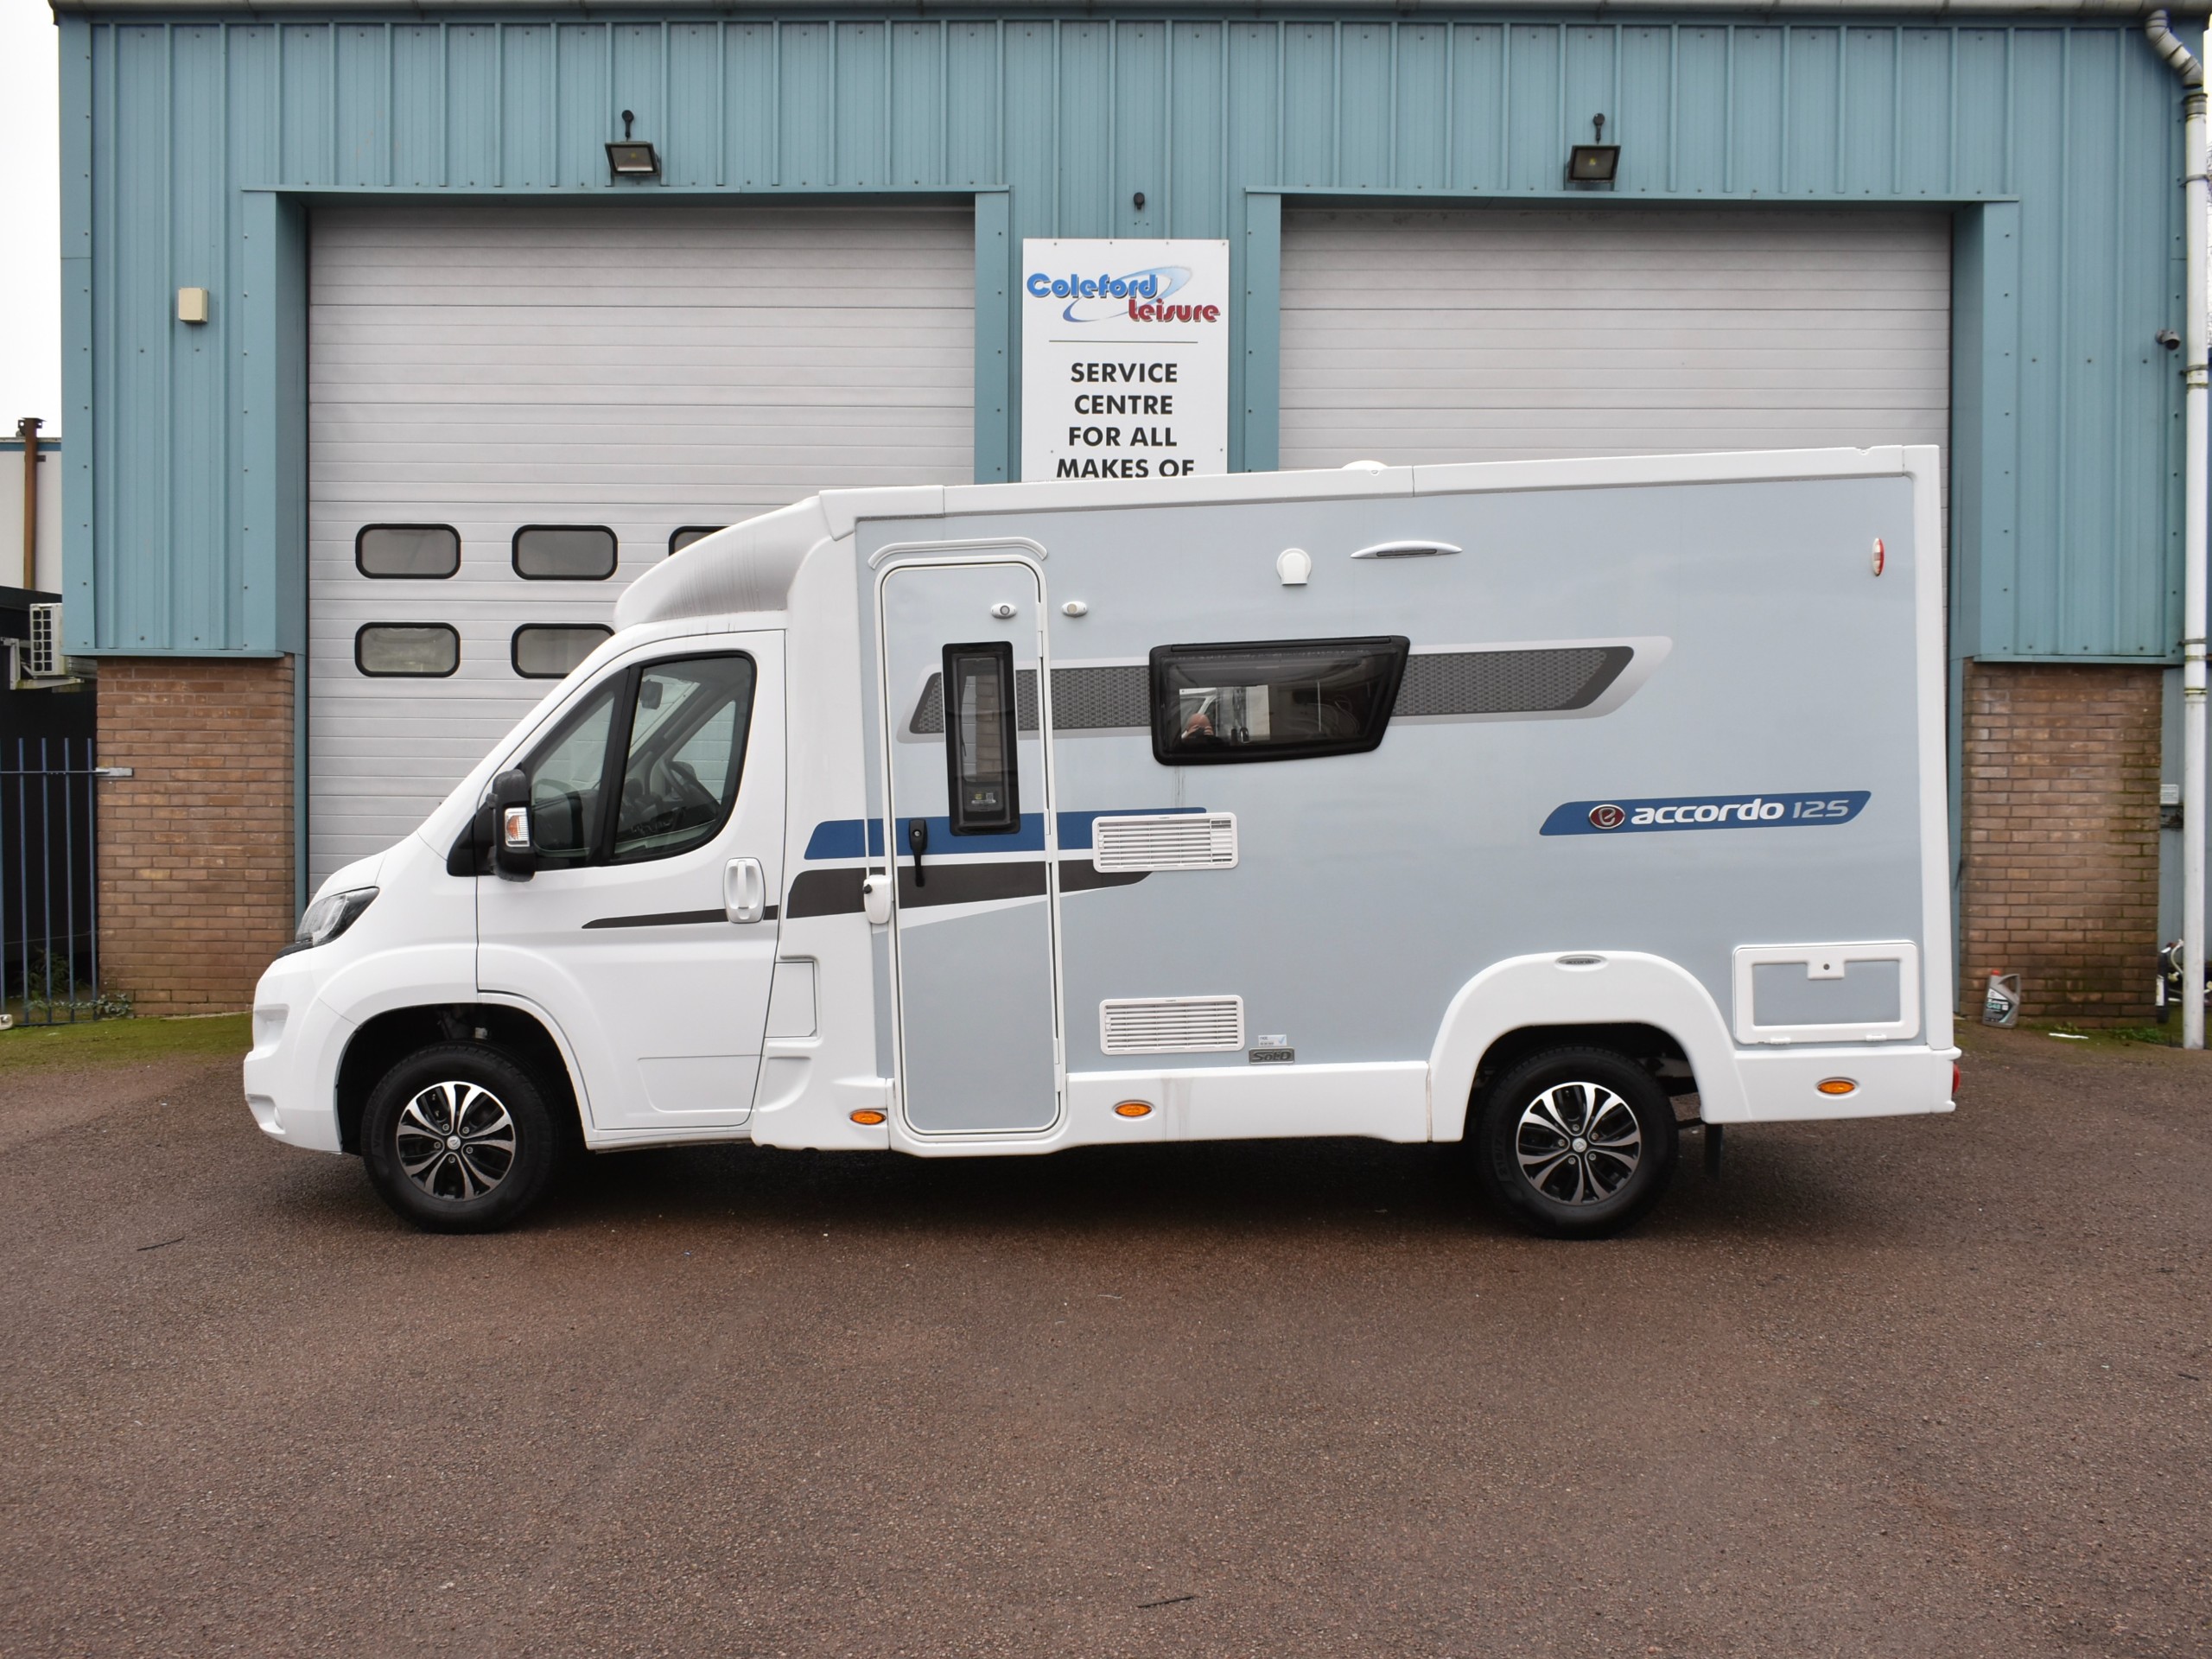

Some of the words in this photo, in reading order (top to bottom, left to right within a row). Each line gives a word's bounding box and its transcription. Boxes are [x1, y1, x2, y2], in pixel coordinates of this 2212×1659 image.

[1027, 272, 1158, 299] Coleford
[1128, 298, 1221, 323] Leisure
[1071, 362, 1178, 383] SERVICE
[1074, 394, 1173, 415] CENTRE
[1069, 427, 1121, 447] FOR
[1129, 427, 1178, 447] ALL
[1056, 459, 1149, 479] MAKES
[1159, 459, 1195, 477] OF
[1630, 798, 1785, 825] accordo
[1792, 799, 1850, 819] 125
